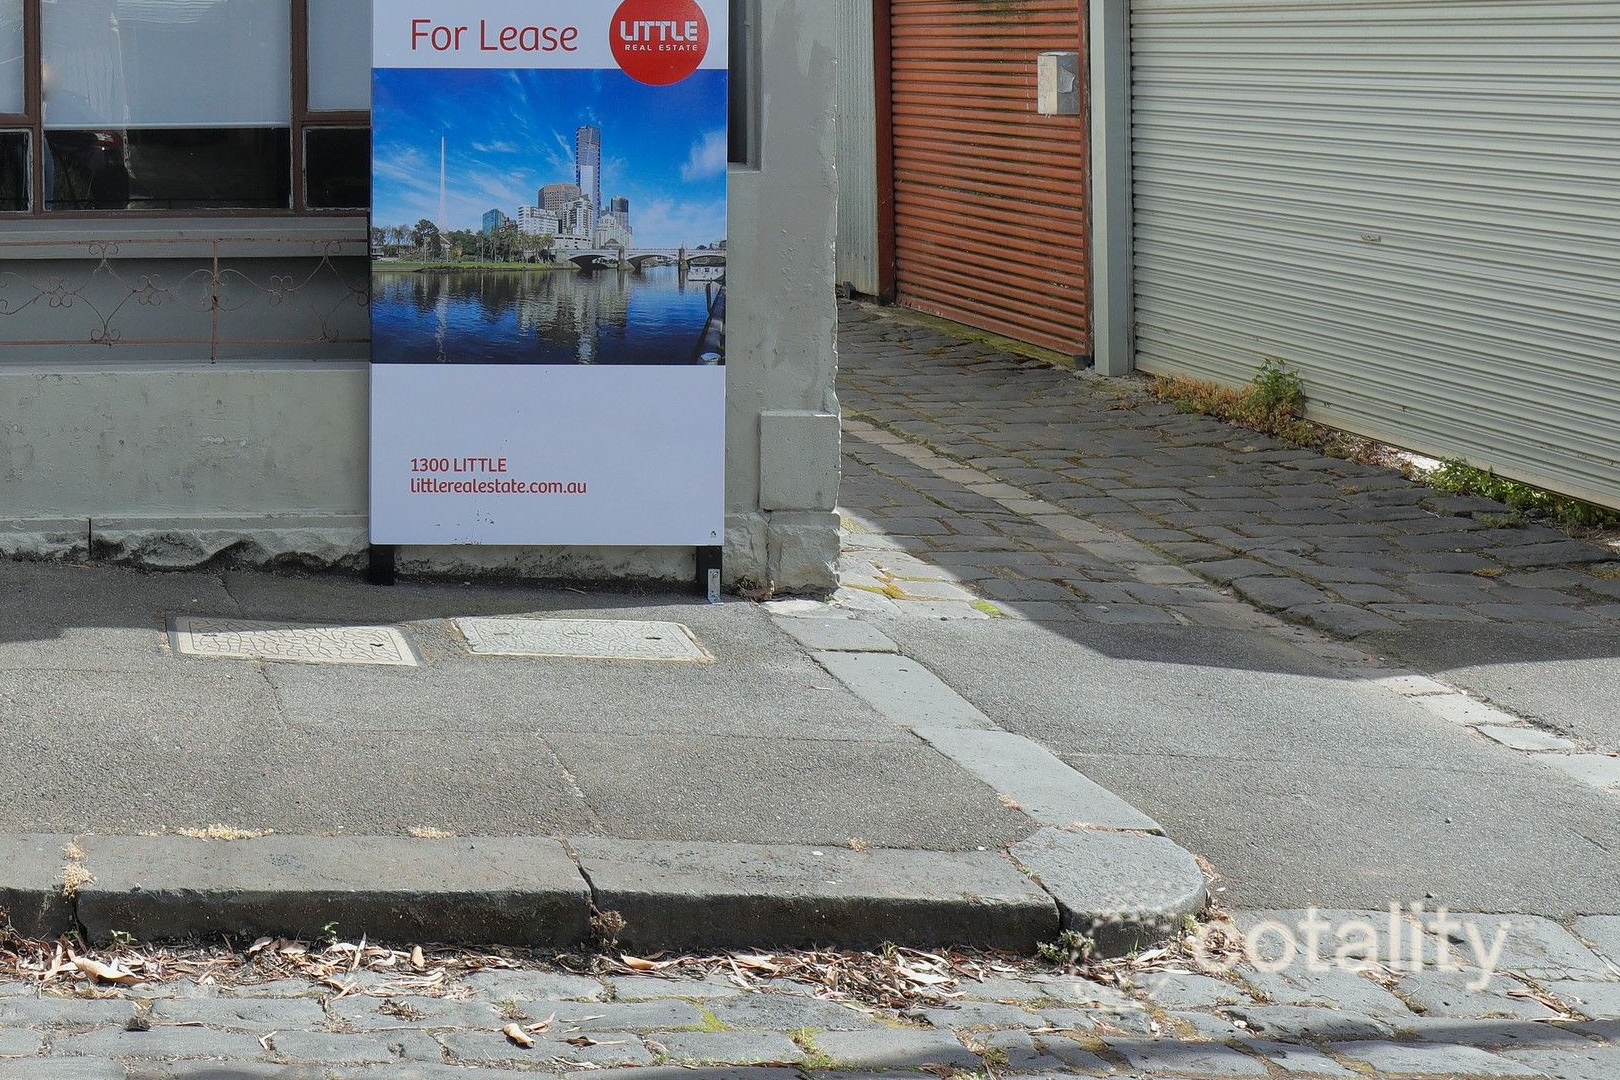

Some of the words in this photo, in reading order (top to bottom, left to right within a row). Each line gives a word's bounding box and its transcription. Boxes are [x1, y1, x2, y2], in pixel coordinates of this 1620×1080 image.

[411, 19, 468, 51] For
[480, 19, 579, 52] Lease
[620, 21, 698, 41] LITTLE
[411, 458, 449, 472] 1300
[453, 458, 507, 472] LITTLE
[410, 478, 587, 493] littlerealestate.com.au
